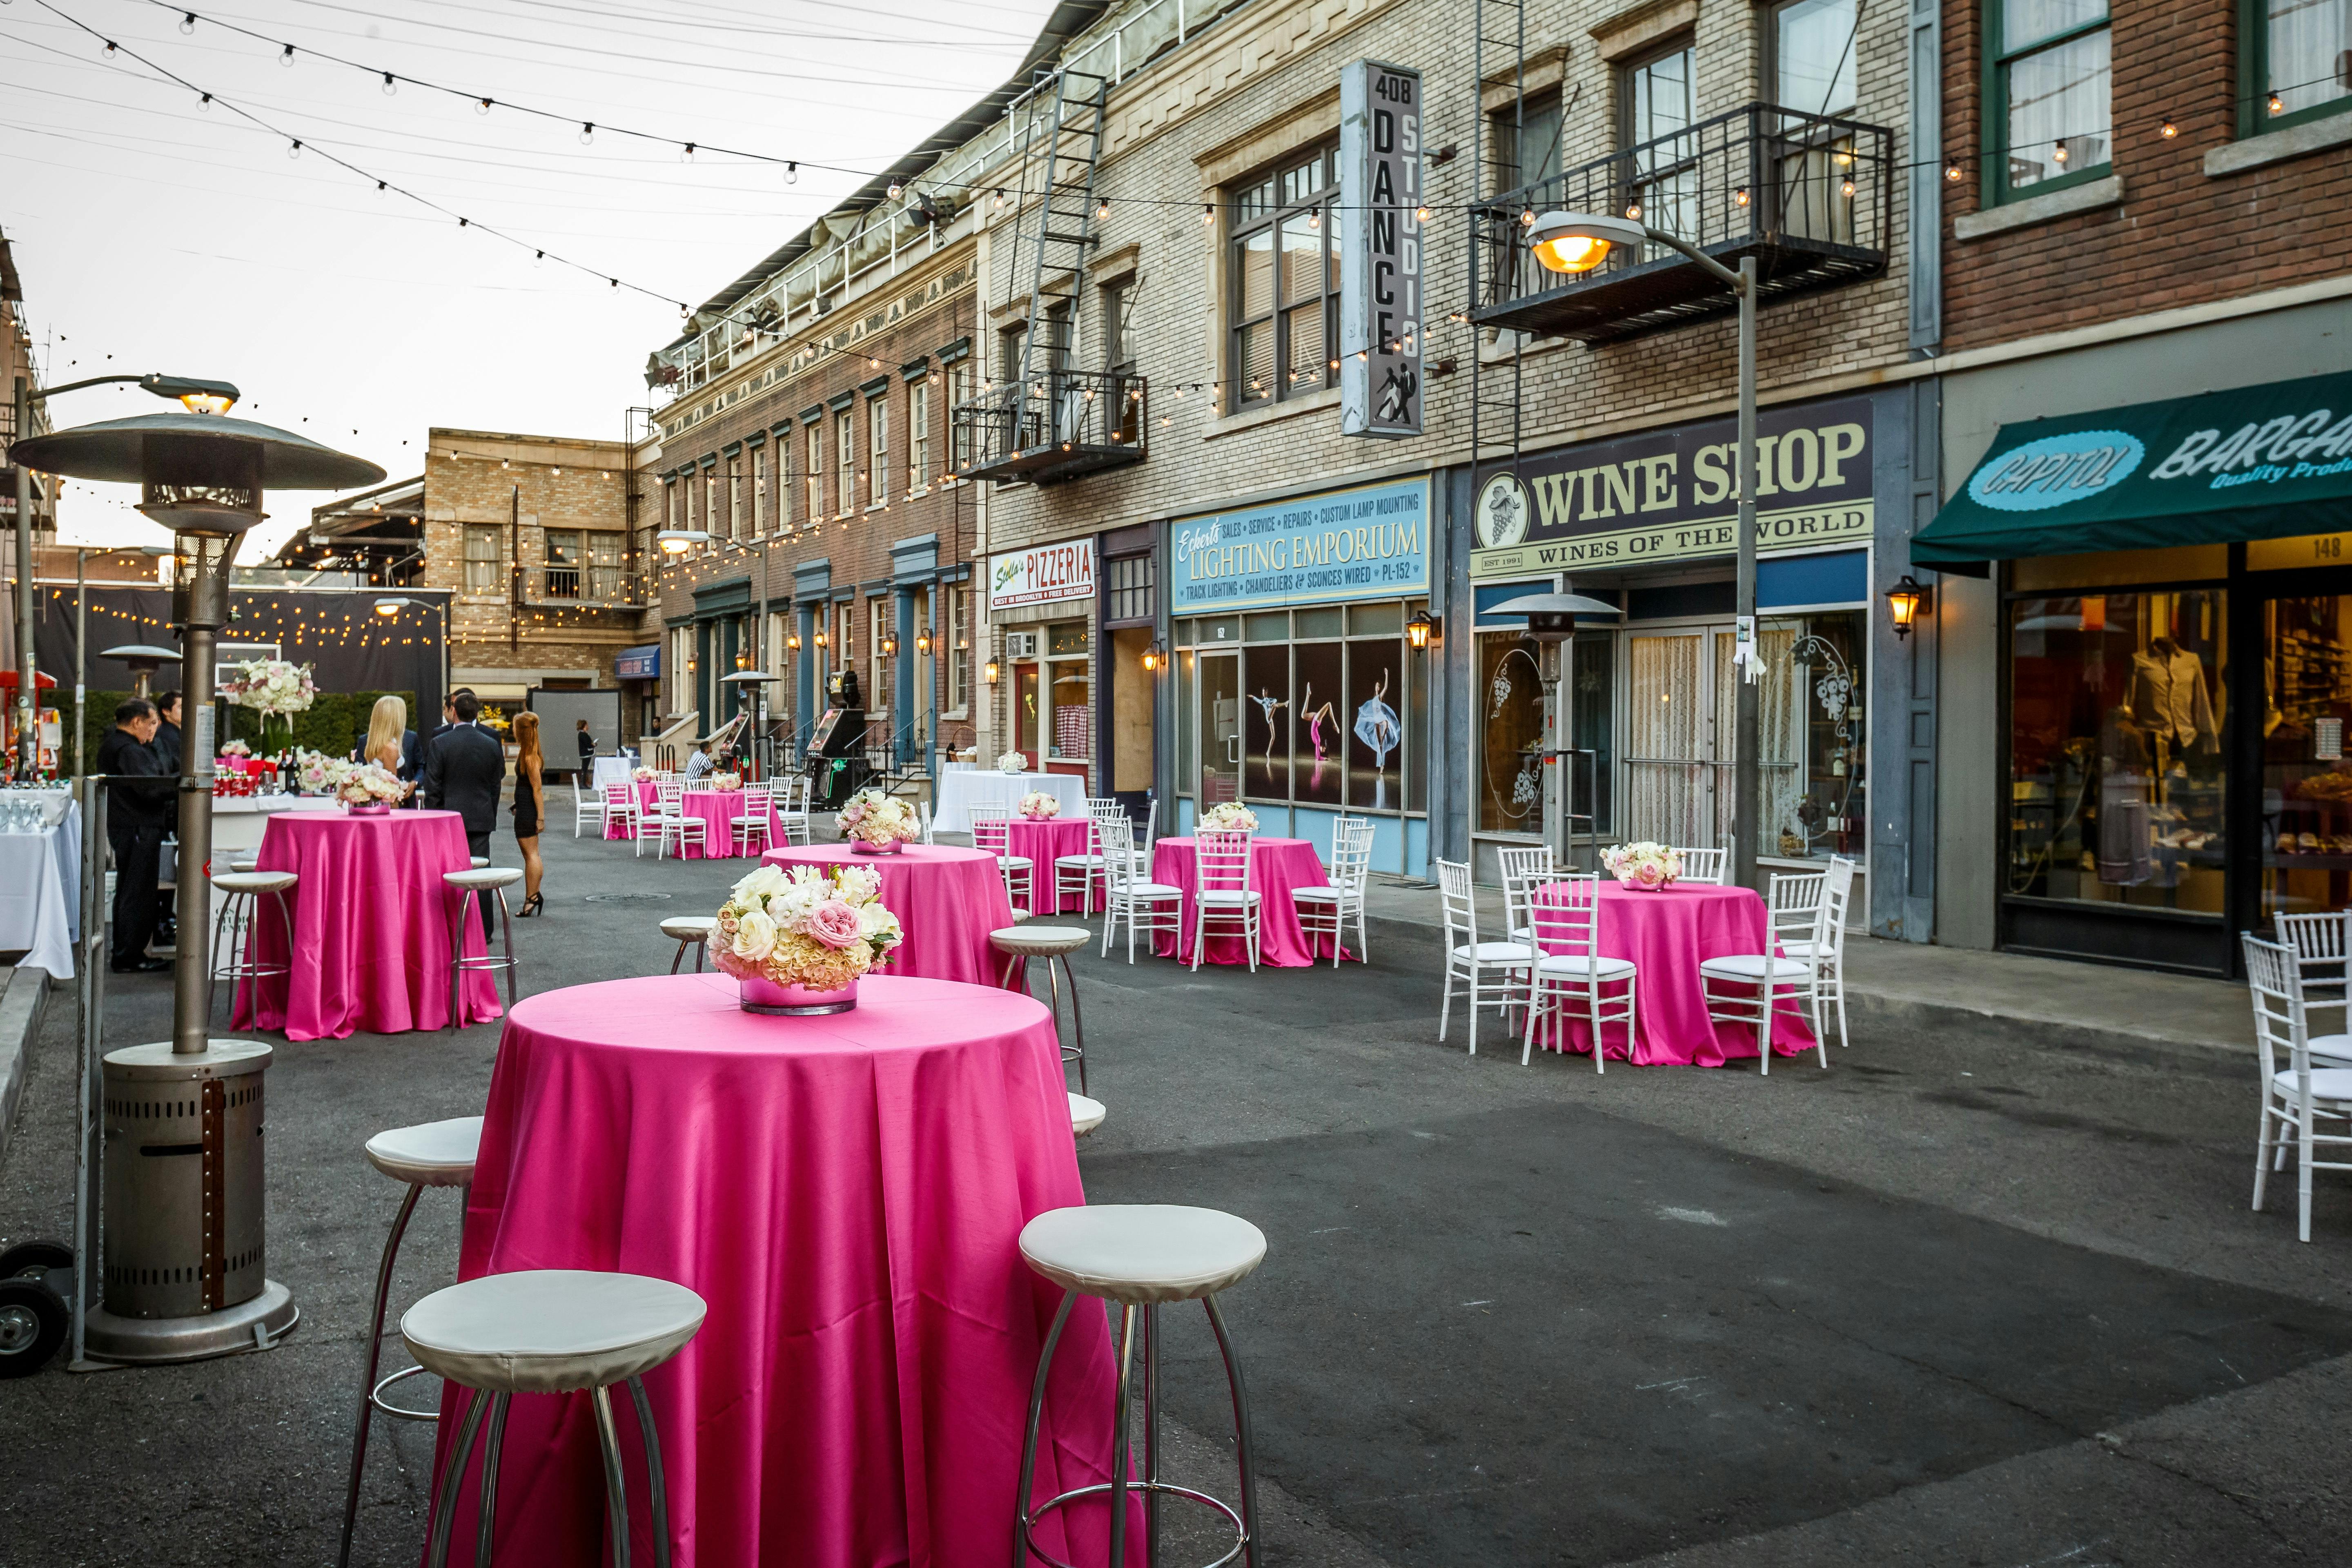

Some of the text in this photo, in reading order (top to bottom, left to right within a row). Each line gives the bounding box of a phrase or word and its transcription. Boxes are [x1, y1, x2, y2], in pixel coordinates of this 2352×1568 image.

[1375, 74, 1412, 105] 408
[1370, 107, 1396, 356] DANCE
[1401, 114, 1418, 358] STUDIO
[1532, 423, 1865, 526] WINE SHOP
[1982, 445, 2130, 495] CAPITOL
[2209, 464, 2289, 489] Quality
[1222, 493, 1419, 539] SALES SERVICE REPAIRS CUSTOM LAMP MOUNTING
[1178, 517, 1221, 563] Eckert's
[1189, 519, 1421, 581] LIGHTING EMPORIUM
[1538, 541, 1619, 564] WINES
[1629, 535, 1664, 554] OF
[1675, 526, 1733, 548] THE
[2314, 537, 2341, 559] 148
[995, 559, 1025, 591] Stella's
[1027, 544, 1091, 589] PIZZERIA
[1186, 561, 1410, 600] TRACK LIGHTING CHANDELIERS & SCONCES WIRED PL-152
[1484, 559, 1499, 567] EST
[994, 597, 1008, 605] BEST
[1015, 592, 1042, 602] BROOKLYN
[1048, 589, 1062, 598] FREE
[1063, 585, 1091, 596] DELIVERY
